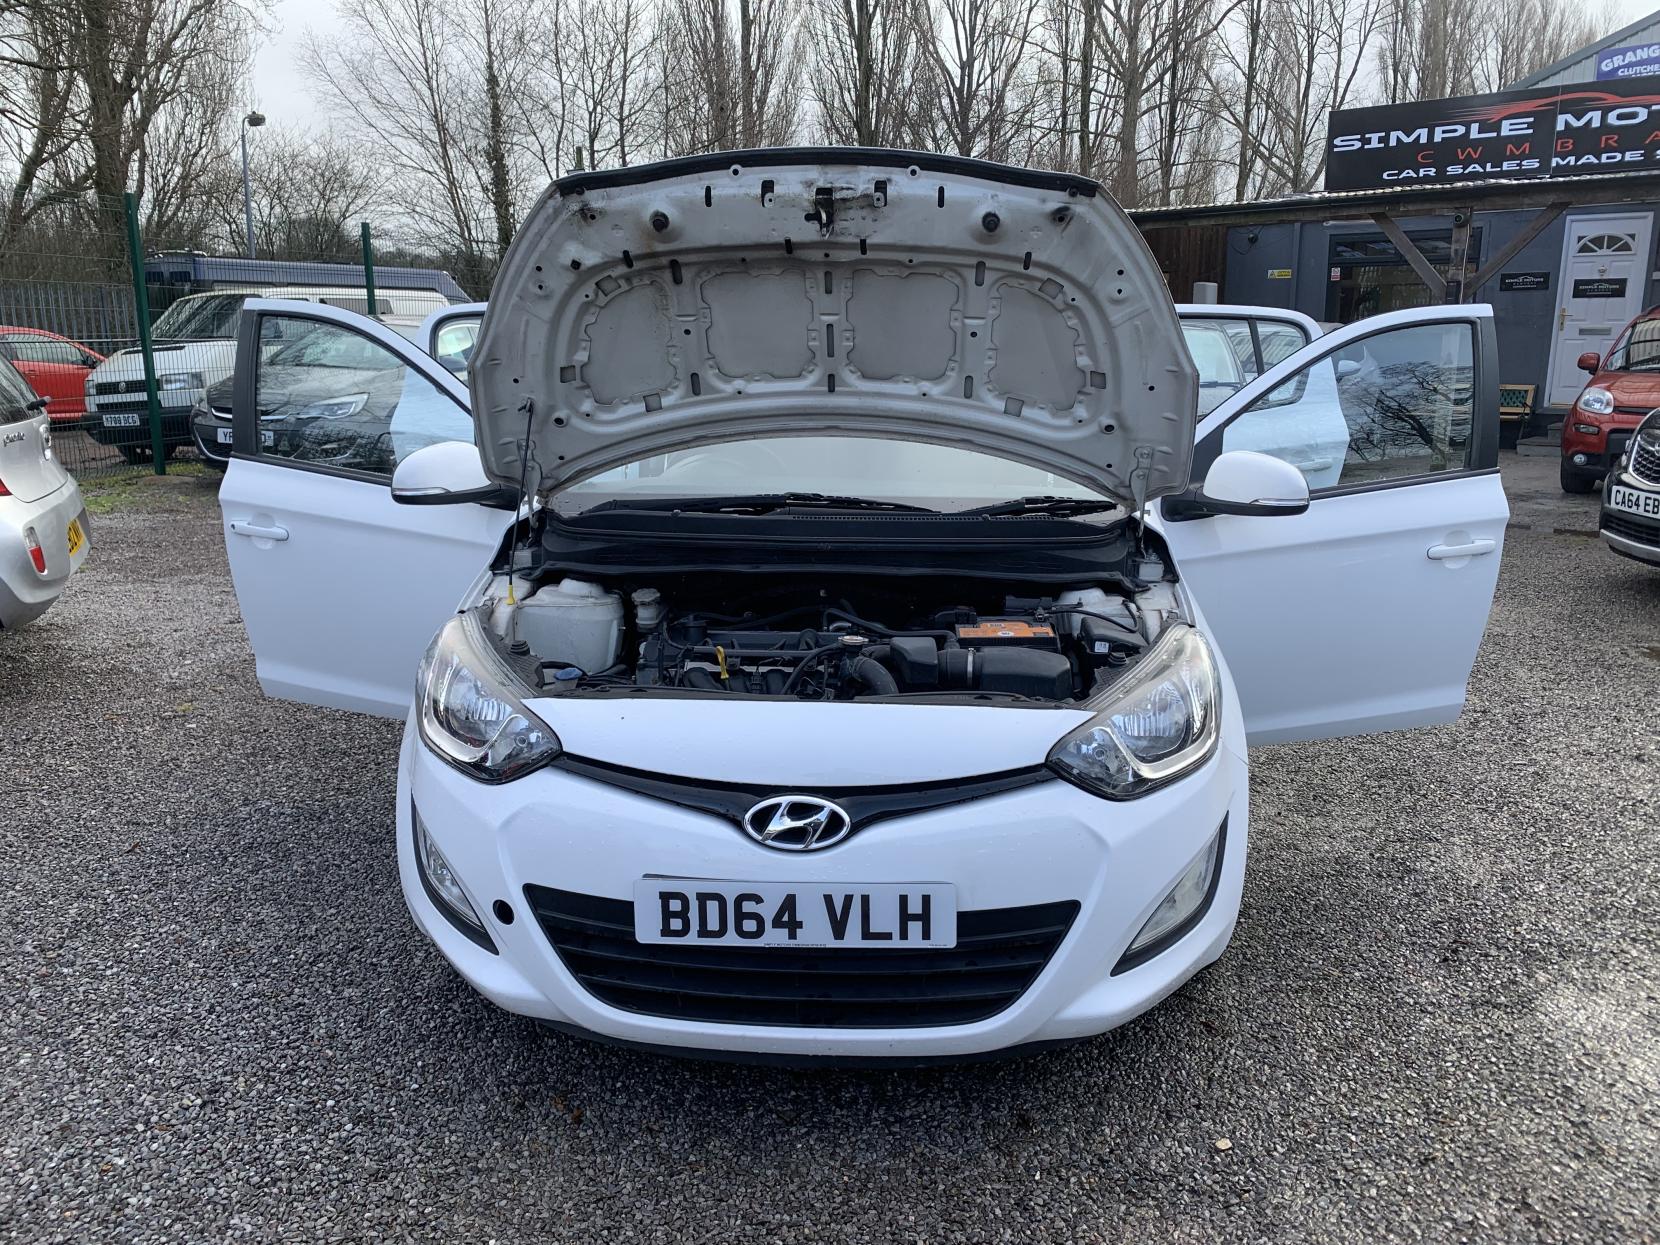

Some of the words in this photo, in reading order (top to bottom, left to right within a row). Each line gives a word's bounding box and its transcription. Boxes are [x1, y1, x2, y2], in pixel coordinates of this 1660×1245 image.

[1333, 117, 1534, 152] SIMPLE
[1382, 167, 1437, 180] CAR
[1446, 158, 1540, 176] SALES
[1551, 150, 1645, 167] MADE
[1614, 489, 1641, 511] CA64
[1643, 496, 1660, 515] EB
[658, 891, 804, 940] BD64
[822, 893, 932, 941] VLH
